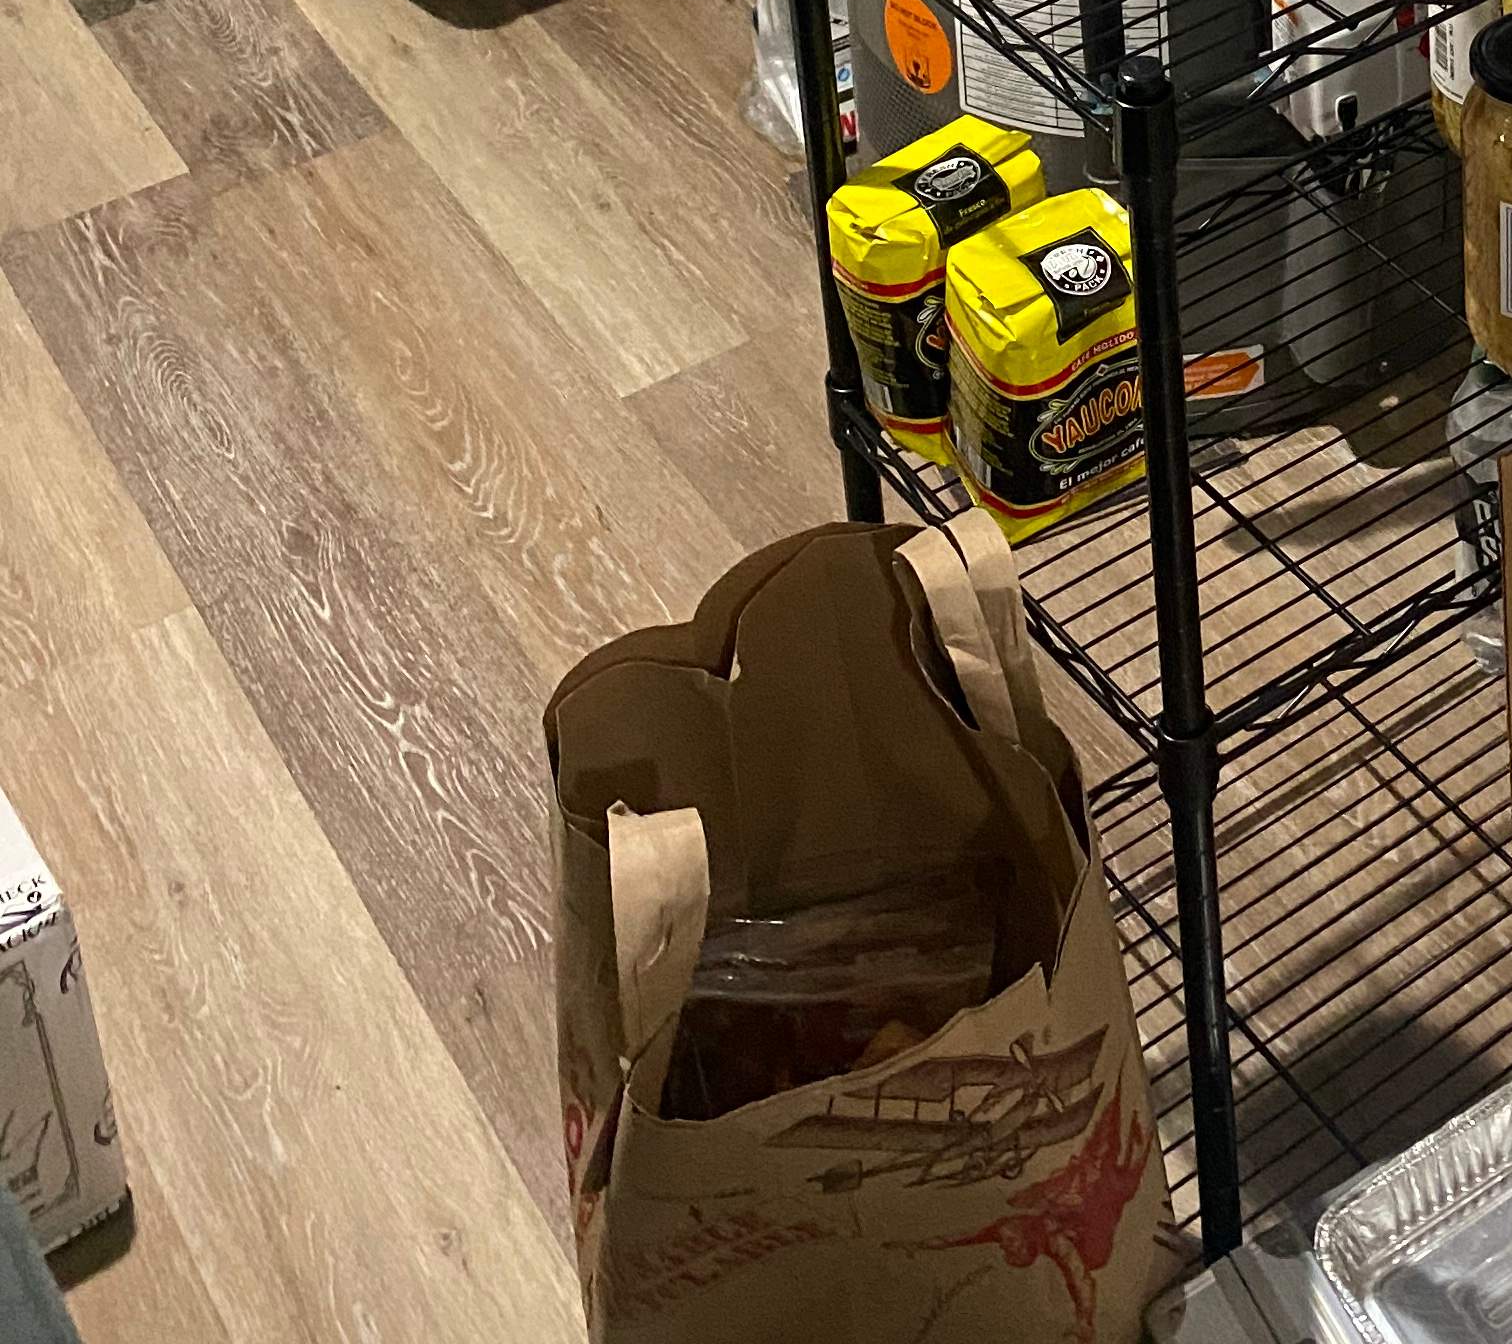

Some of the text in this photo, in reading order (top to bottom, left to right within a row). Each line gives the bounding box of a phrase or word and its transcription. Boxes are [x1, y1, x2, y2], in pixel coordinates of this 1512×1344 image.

[1074, 275, 1104, 292] PACK
[1059, 477, 1073, 490] El
[1077, 454, 1119, 482] mejor
